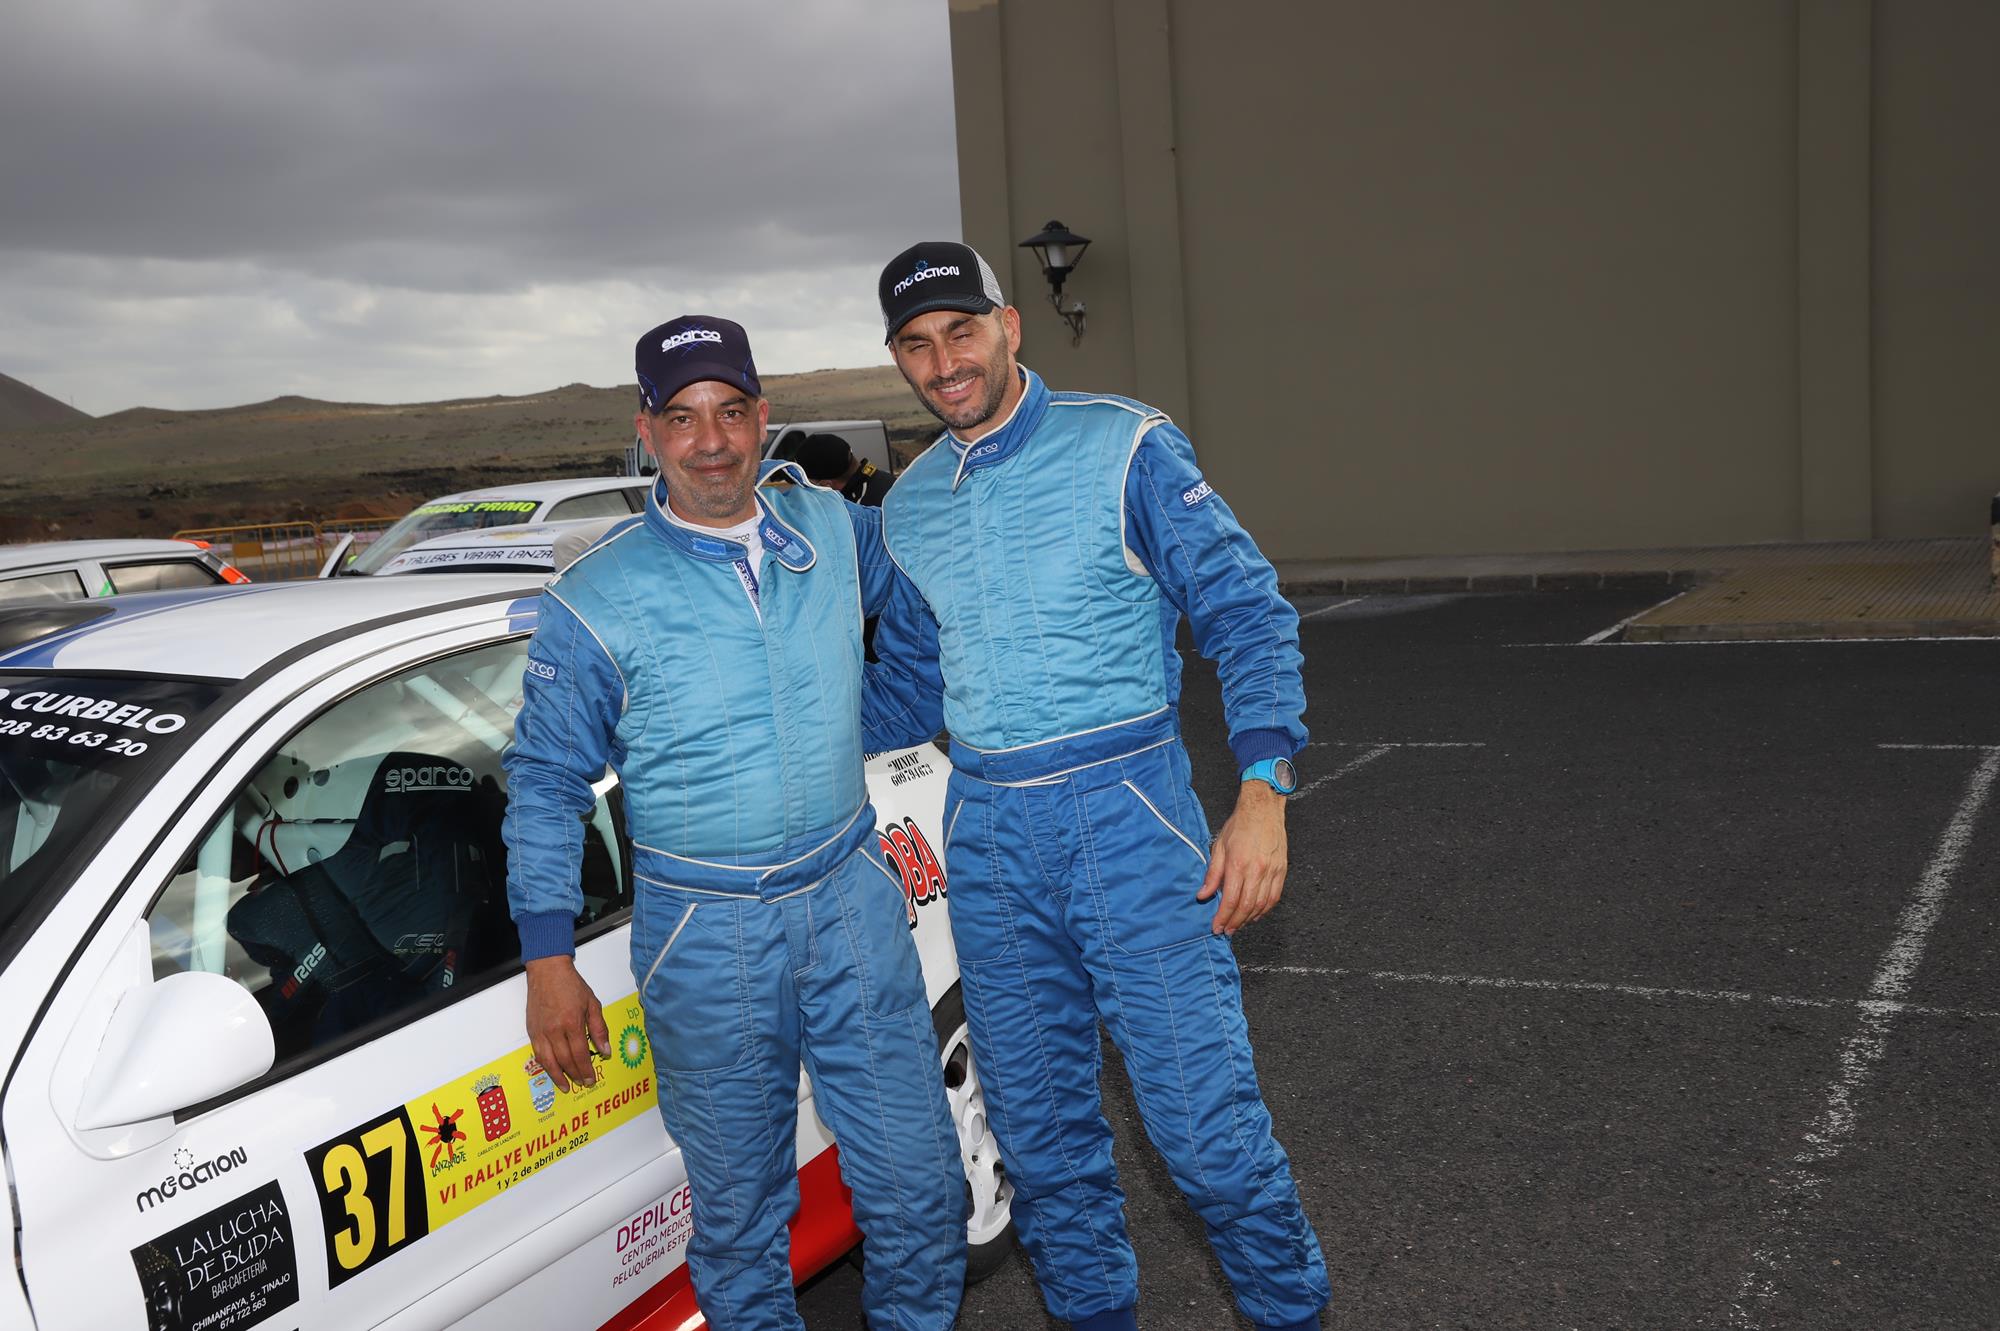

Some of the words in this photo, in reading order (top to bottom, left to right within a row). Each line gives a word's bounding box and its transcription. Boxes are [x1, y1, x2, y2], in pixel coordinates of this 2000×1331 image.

[662, 330, 722, 352] sparco
[473, 502, 536, 513] PRIMO
[406, 552, 460, 567] TALLERES
[11, 691, 186, 734] CURBELO
[0, 718, 32, 736] 28
[31, 724, 70, 741] 83
[68, 731, 108, 747] 63
[105, 738, 148, 757] 20
[385, 766, 474, 792] sparco
[294, 942, 327, 984] RRS
[626, 1007, 640, 1020] bp
[439, 1183, 457, 1205] VI
[464, 1147, 522, 1193] RALLYE
[525, 1123, 568, 1157] VILLA
[571, 1110, 590, 1133] DE
[595, 1077, 651, 1120] TEGUISE
[496, 1180, 502, 1190] 1
[504, 1178, 511, 1189] y
[512, 1171, 519, 1183] 2
[520, 1165, 532, 1177] de
[534, 1152, 555, 1168] abril
[556, 1146, 567, 1158] de
[569, 1131, 589, 1150] 2022
[322, 1116, 407, 1270] 37
[187, 1257, 222, 1292] DE
[222, 1226, 284, 1273] BUDA
[621, 1235, 658, 1266] CENTRO
[660, 1212, 692, 1241] MEDICO
[251, 1291, 256, 1301] 5
[261, 1272, 291, 1295] TINAJO
[612, 1246, 665, 1289] PELUQUERIA
[219, 1315, 235, 1330] 674
[236, 1306, 252, 1320] 722
[252, 1297, 267, 1312] 563
